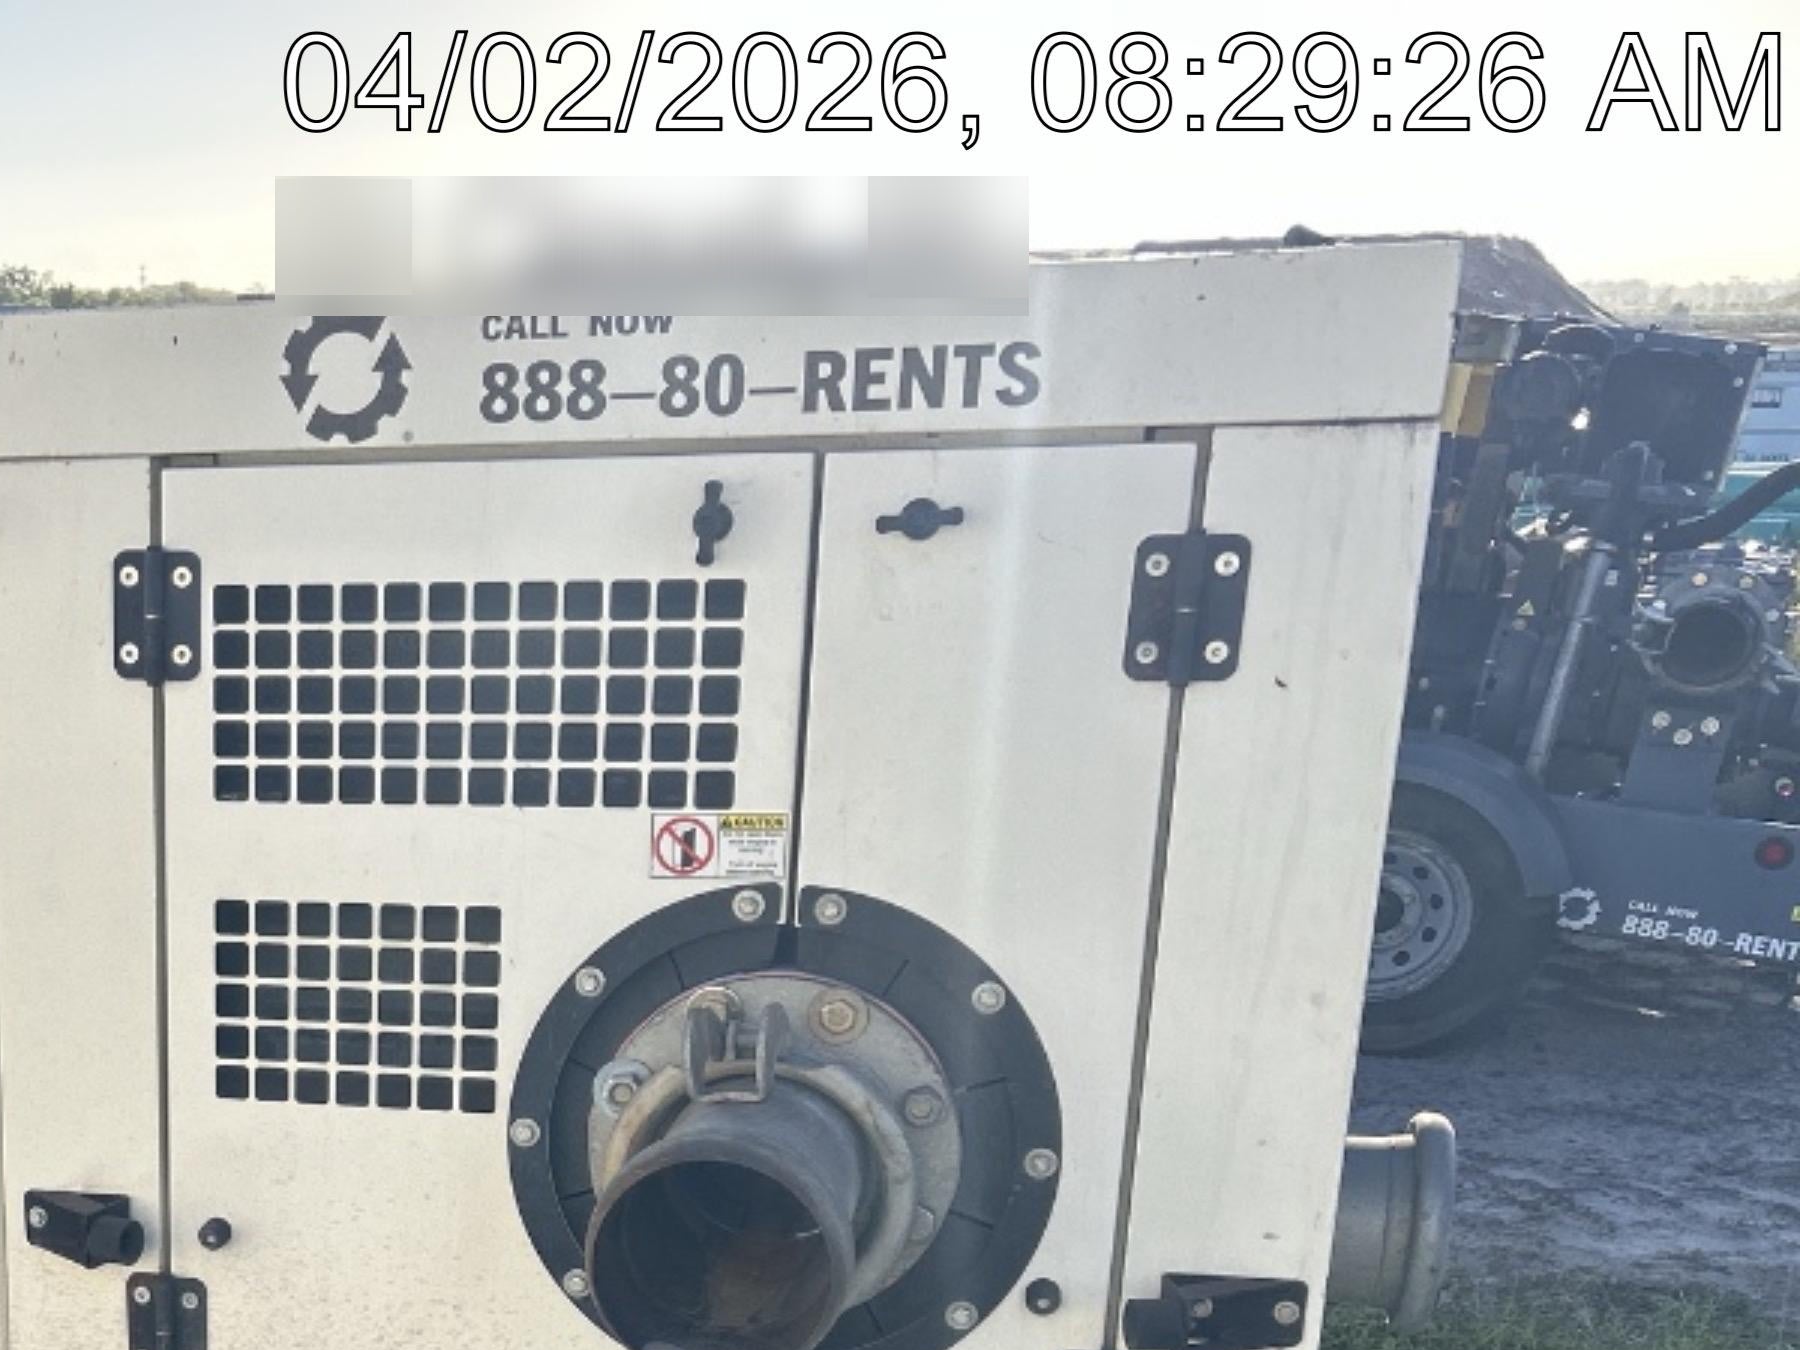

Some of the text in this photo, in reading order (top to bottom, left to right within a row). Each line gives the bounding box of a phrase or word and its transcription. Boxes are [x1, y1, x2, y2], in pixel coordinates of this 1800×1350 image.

[481, 316, 673, 341] CALL NOW
[479, 341, 1040, 424] 888-80-RENTS
